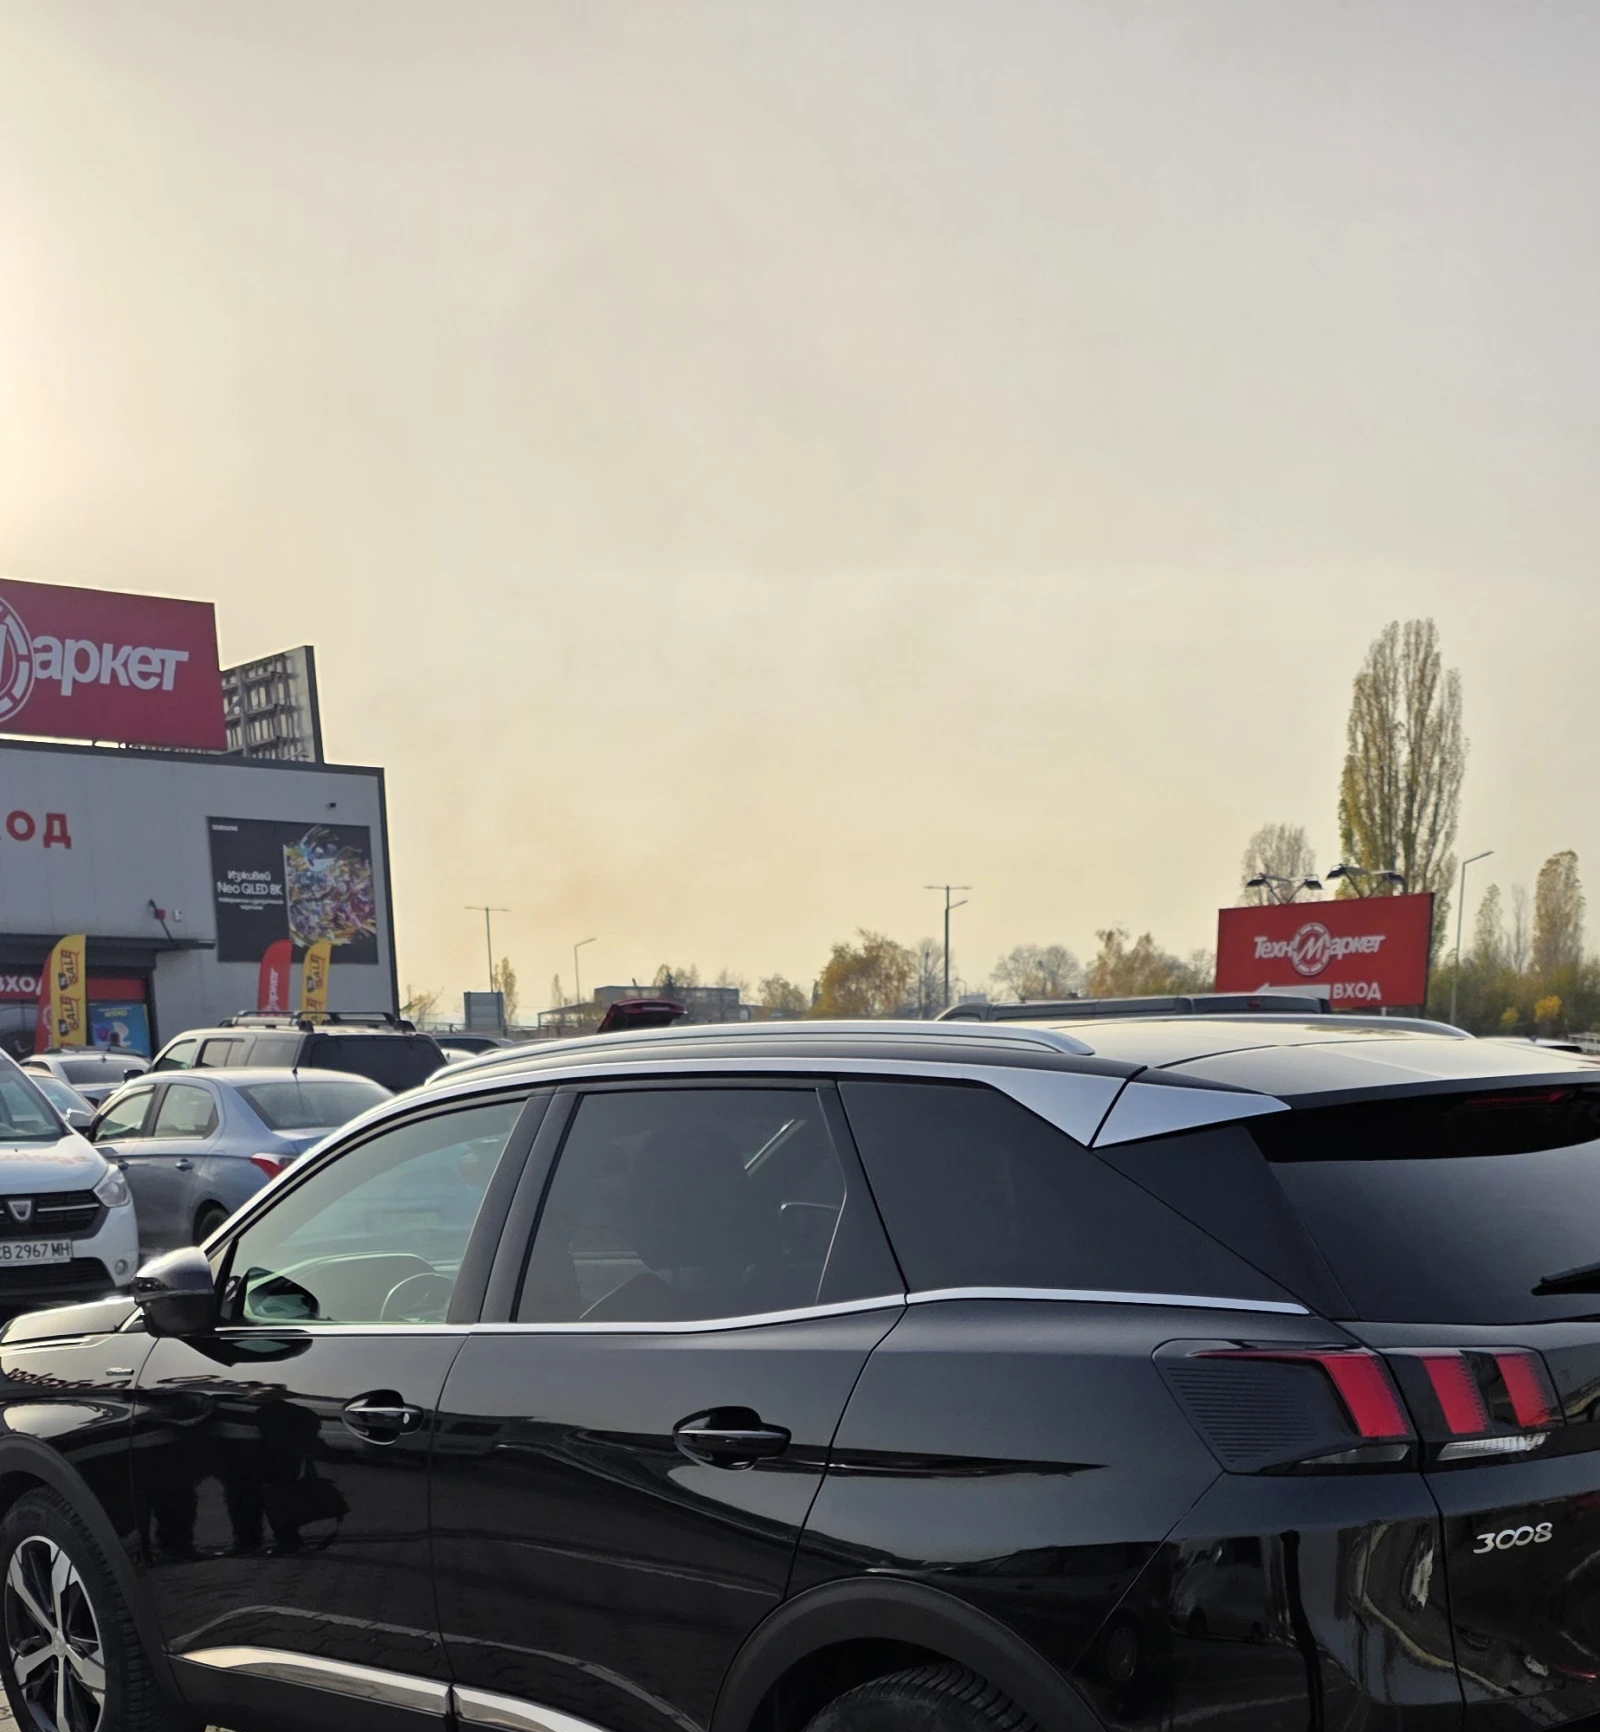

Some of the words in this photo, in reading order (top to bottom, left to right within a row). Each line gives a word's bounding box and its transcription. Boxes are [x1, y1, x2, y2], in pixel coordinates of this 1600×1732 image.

[0, 624, 190, 697] аркет
[5, 810, 72, 850] ОД
[217, 881, 240, 894] Neo
[241, 883, 268, 895] QLED
[269, 883, 283, 895] 8K
[60, 949, 78, 985] SALE
[1332, 982, 1382, 1001] ВХОД
[60, 996, 78, 1030] SALE
[0, 1245, 12, 1260] B
[14, 1243, 48, 1259] 2967
[1473, 1522, 1553, 1554] 3008
